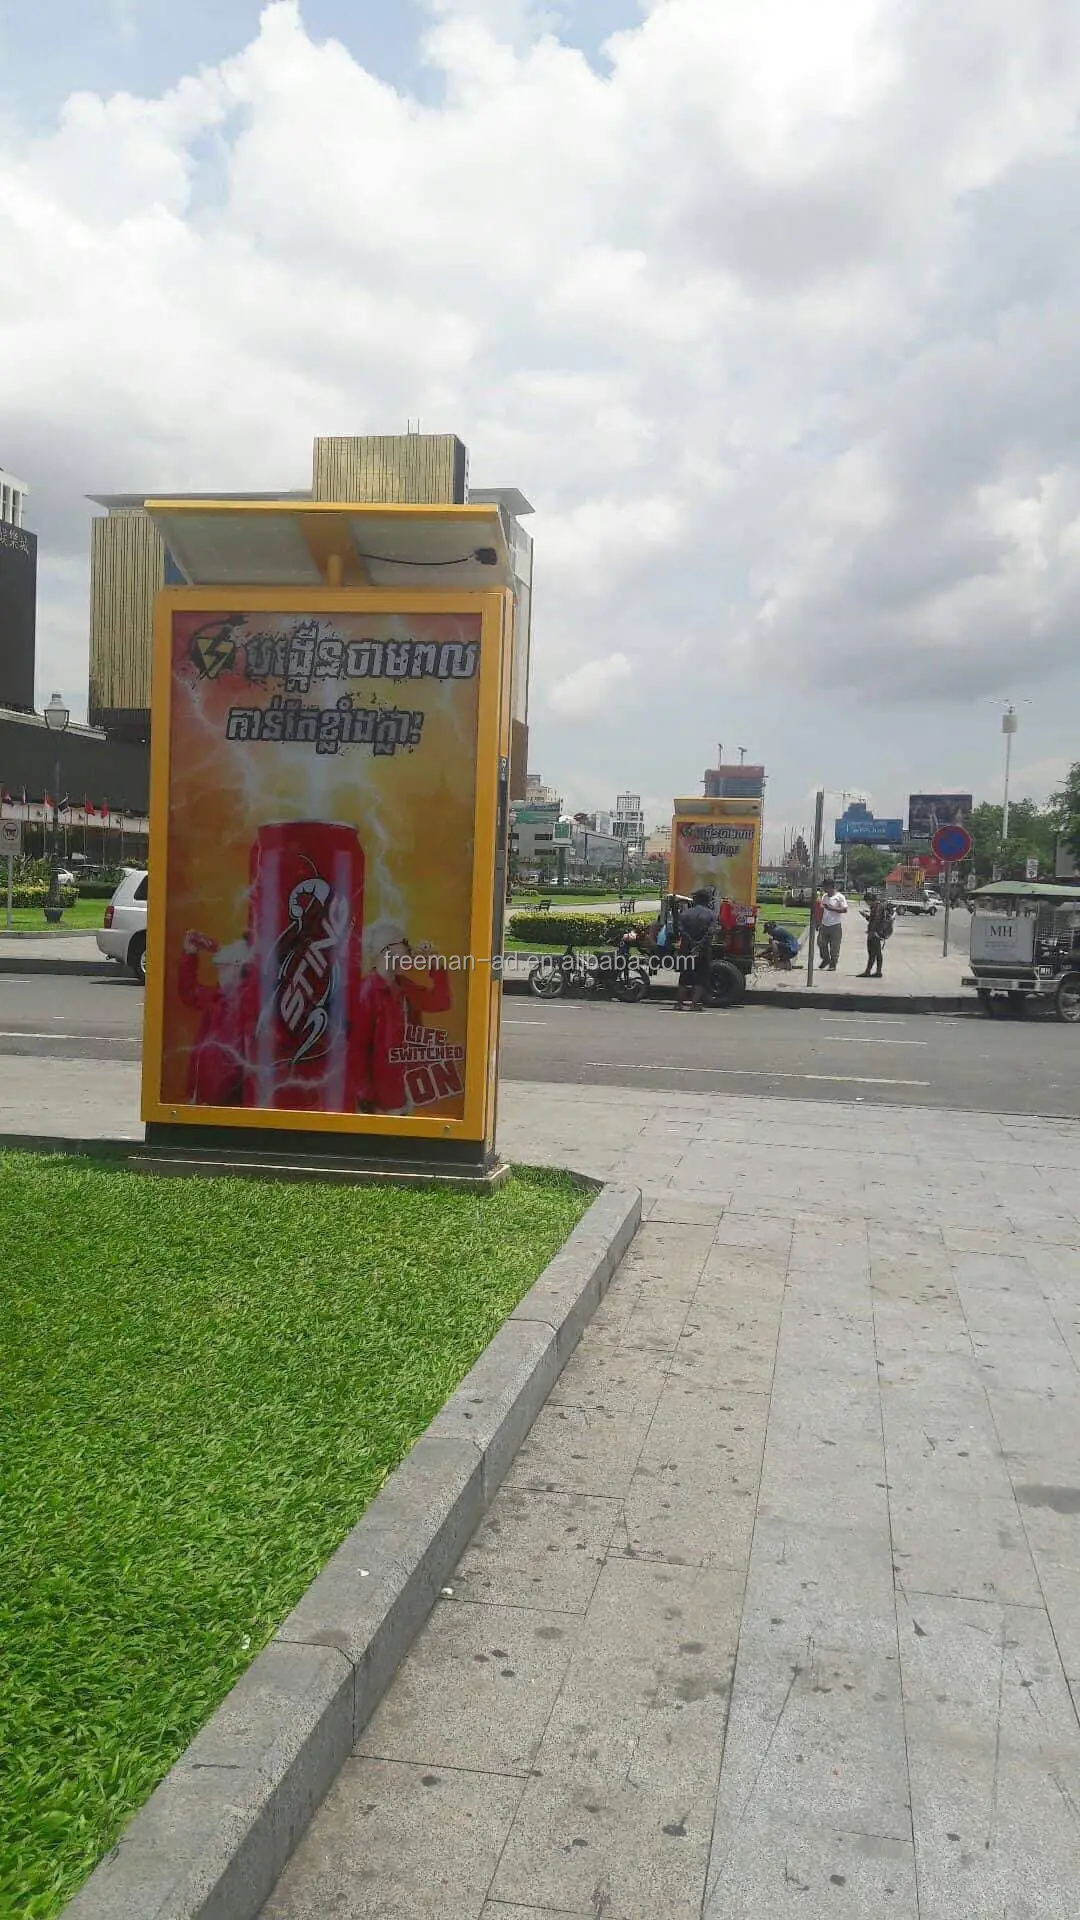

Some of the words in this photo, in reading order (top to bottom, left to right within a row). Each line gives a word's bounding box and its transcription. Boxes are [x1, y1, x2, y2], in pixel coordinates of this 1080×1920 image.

[990, 925, 1012, 938] MH
[281, 893, 350, 1032] STING
[389, 1045, 465, 1063] SWITCHED
[404, 1061, 464, 1106] ON
